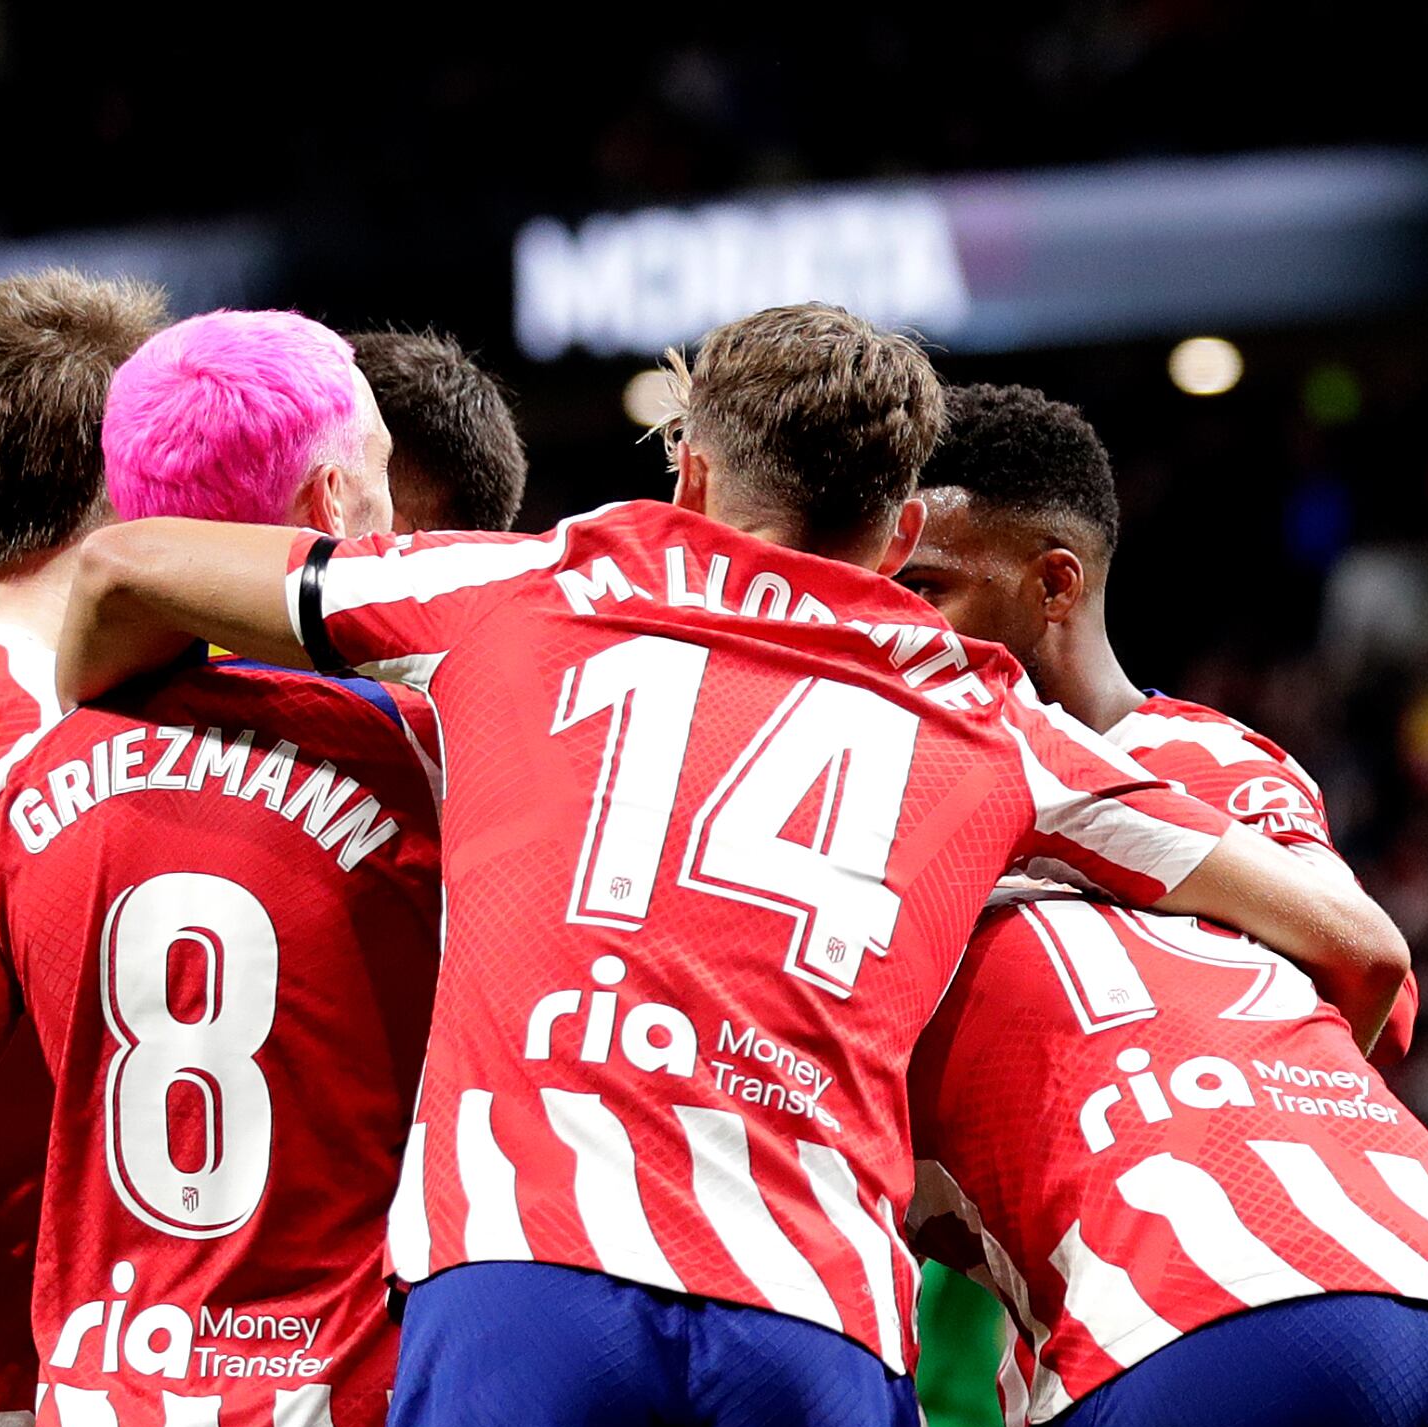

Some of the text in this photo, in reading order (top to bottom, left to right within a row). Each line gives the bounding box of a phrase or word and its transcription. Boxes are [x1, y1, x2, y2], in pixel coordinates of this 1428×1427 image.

[8, 725, 400, 873] GRIEZMANN
[549, 634, 921, 1000] 14
[100, 871, 279, 1241] 8
[524, 954, 699, 1079] ria
[716, 1019, 834, 1101] Money
[1078, 1047, 1256, 1154] ria
[1252, 1059, 1370, 1095] Money
[1262, 1086, 1399, 1126] Transfer
[49, 1260, 194, 1379] ria
[193, 1346, 334, 1379] Transfer
[199, 1305, 321, 1350] Money
